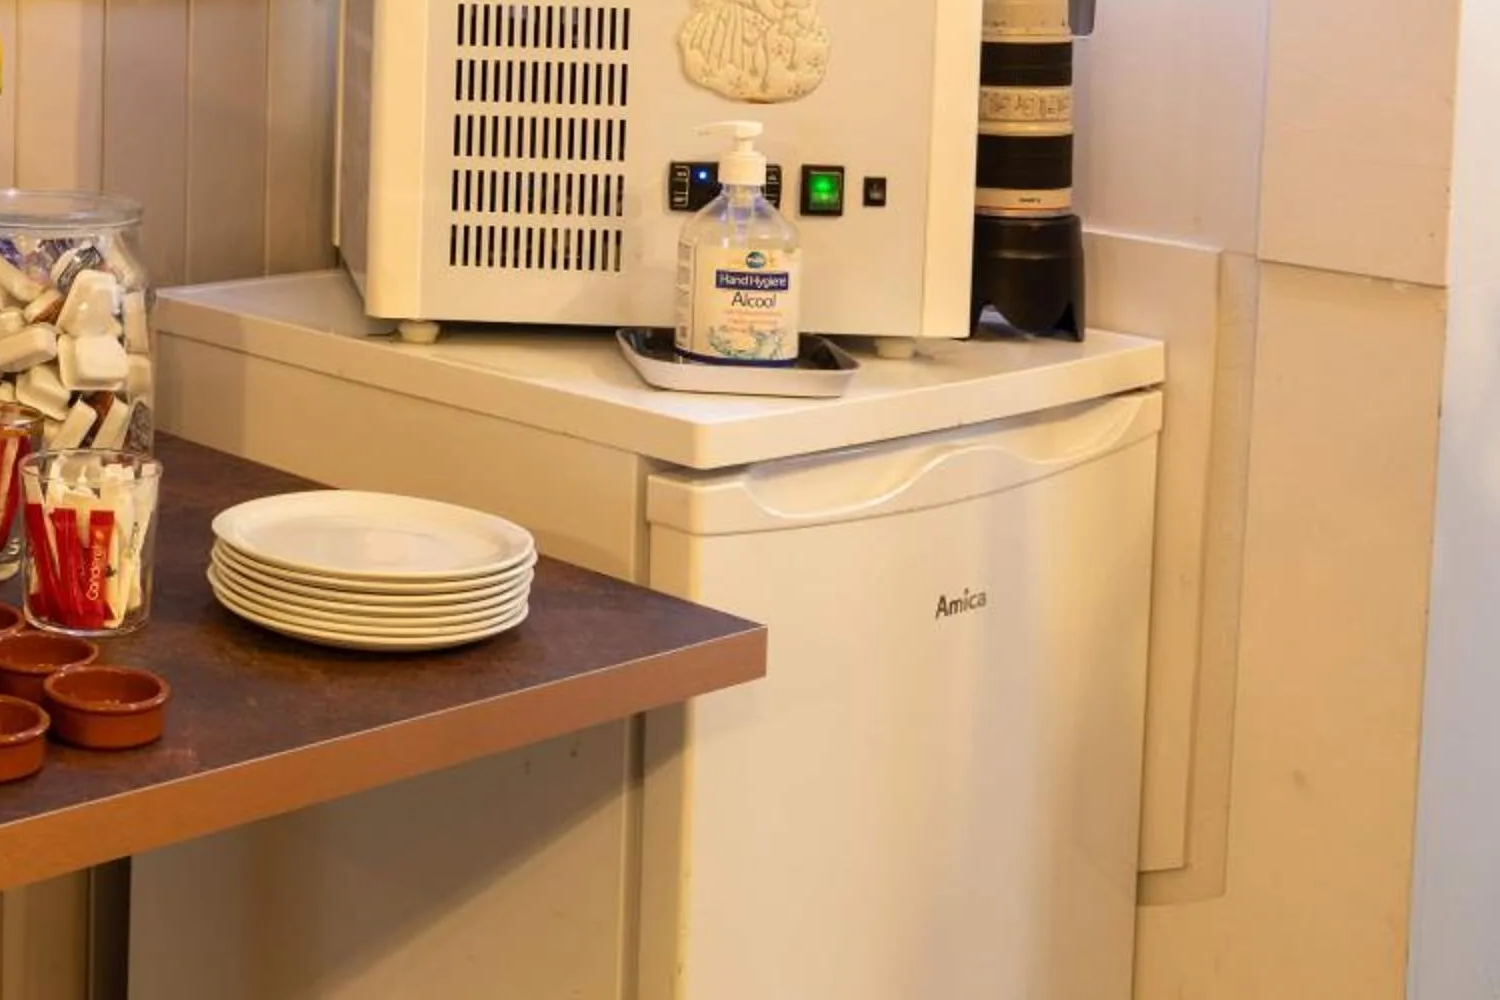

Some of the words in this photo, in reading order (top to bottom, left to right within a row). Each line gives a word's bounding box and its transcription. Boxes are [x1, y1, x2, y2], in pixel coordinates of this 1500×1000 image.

[720, 273, 749, 286] Hand
[731, 291, 777, 308] Alcool
[935, 587, 987, 621] Amica
